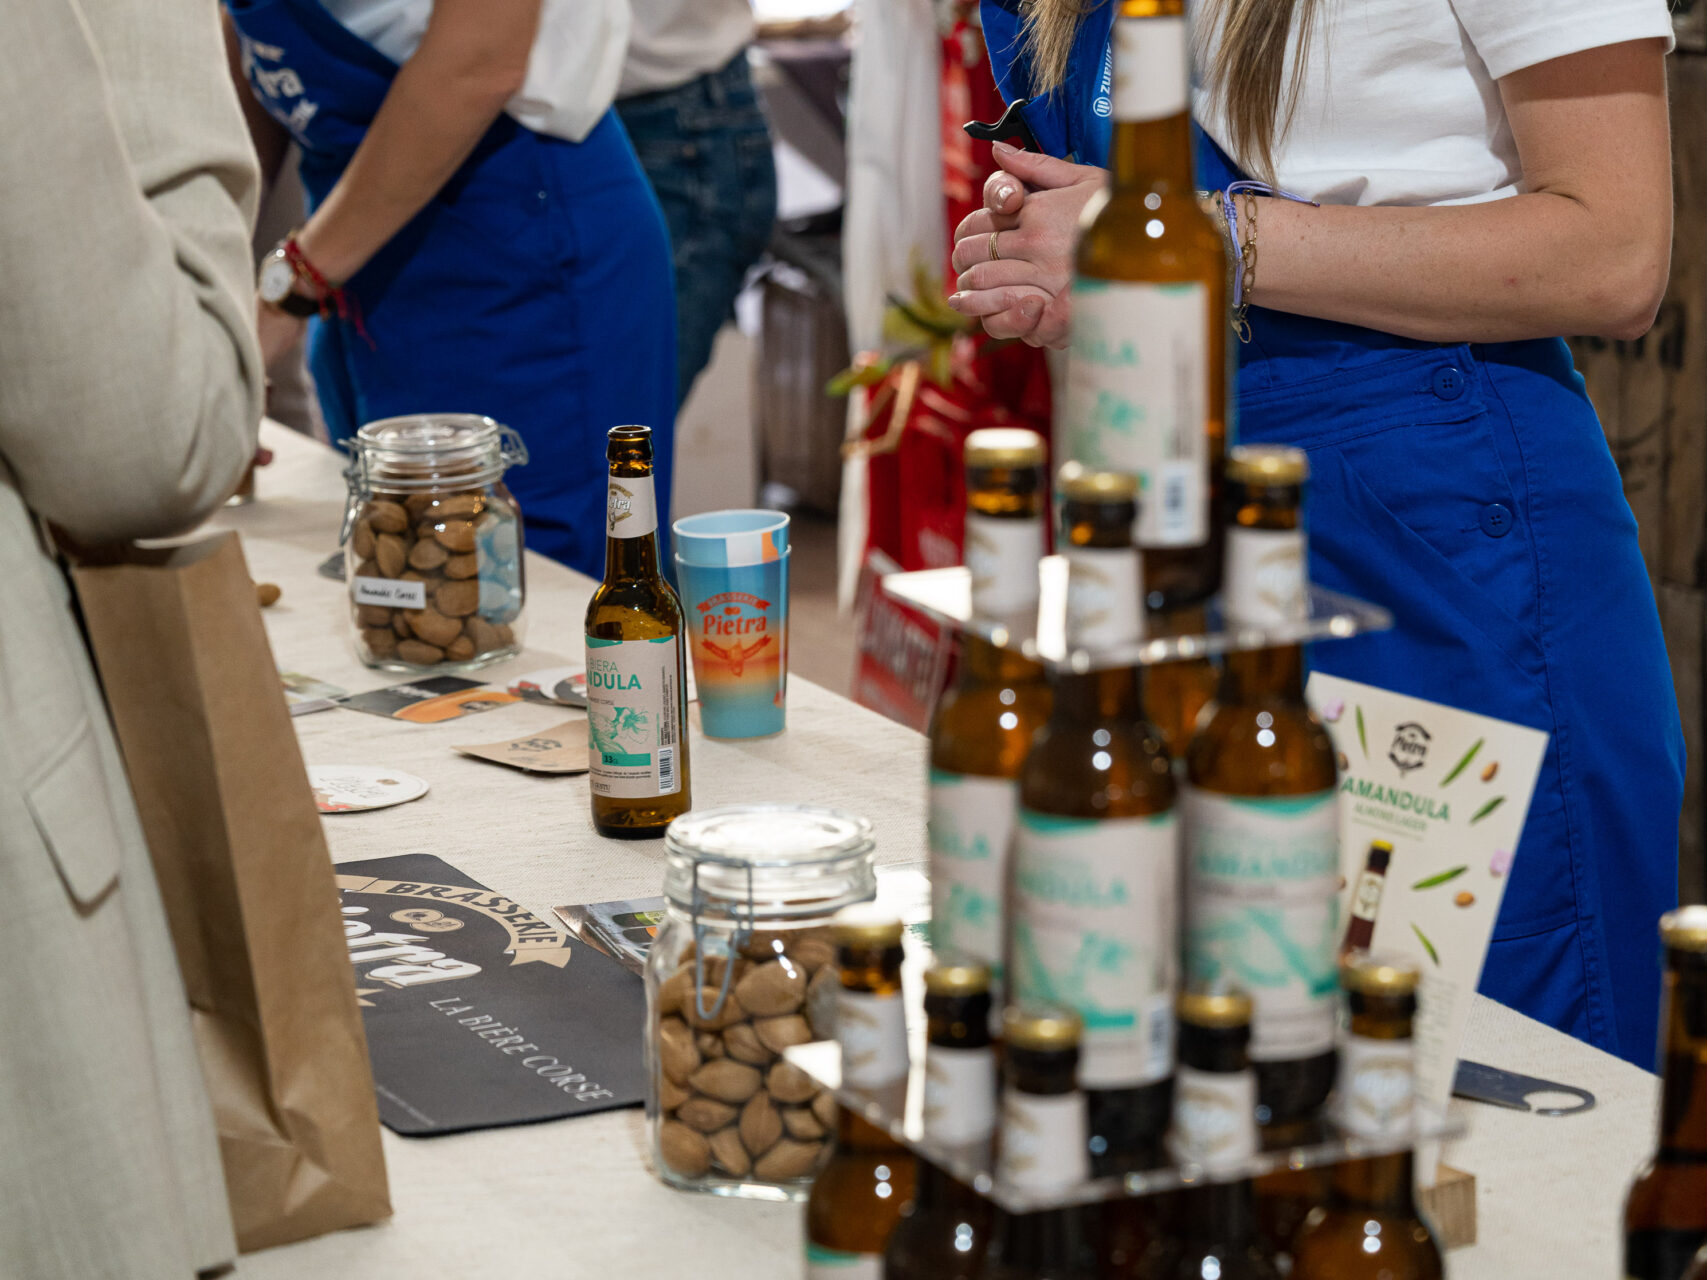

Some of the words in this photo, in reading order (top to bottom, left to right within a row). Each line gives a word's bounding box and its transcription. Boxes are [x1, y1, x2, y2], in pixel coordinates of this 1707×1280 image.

[703, 613, 767, 636] Pietra
[1340, 777, 1451, 823] AMANDULA
[385, 882, 559, 944] BRASSERIE
[429, 996, 475, 1017] LA
[458, 1014, 540, 1055] BIÈRE
[521, 1055, 615, 1102] CORSE
